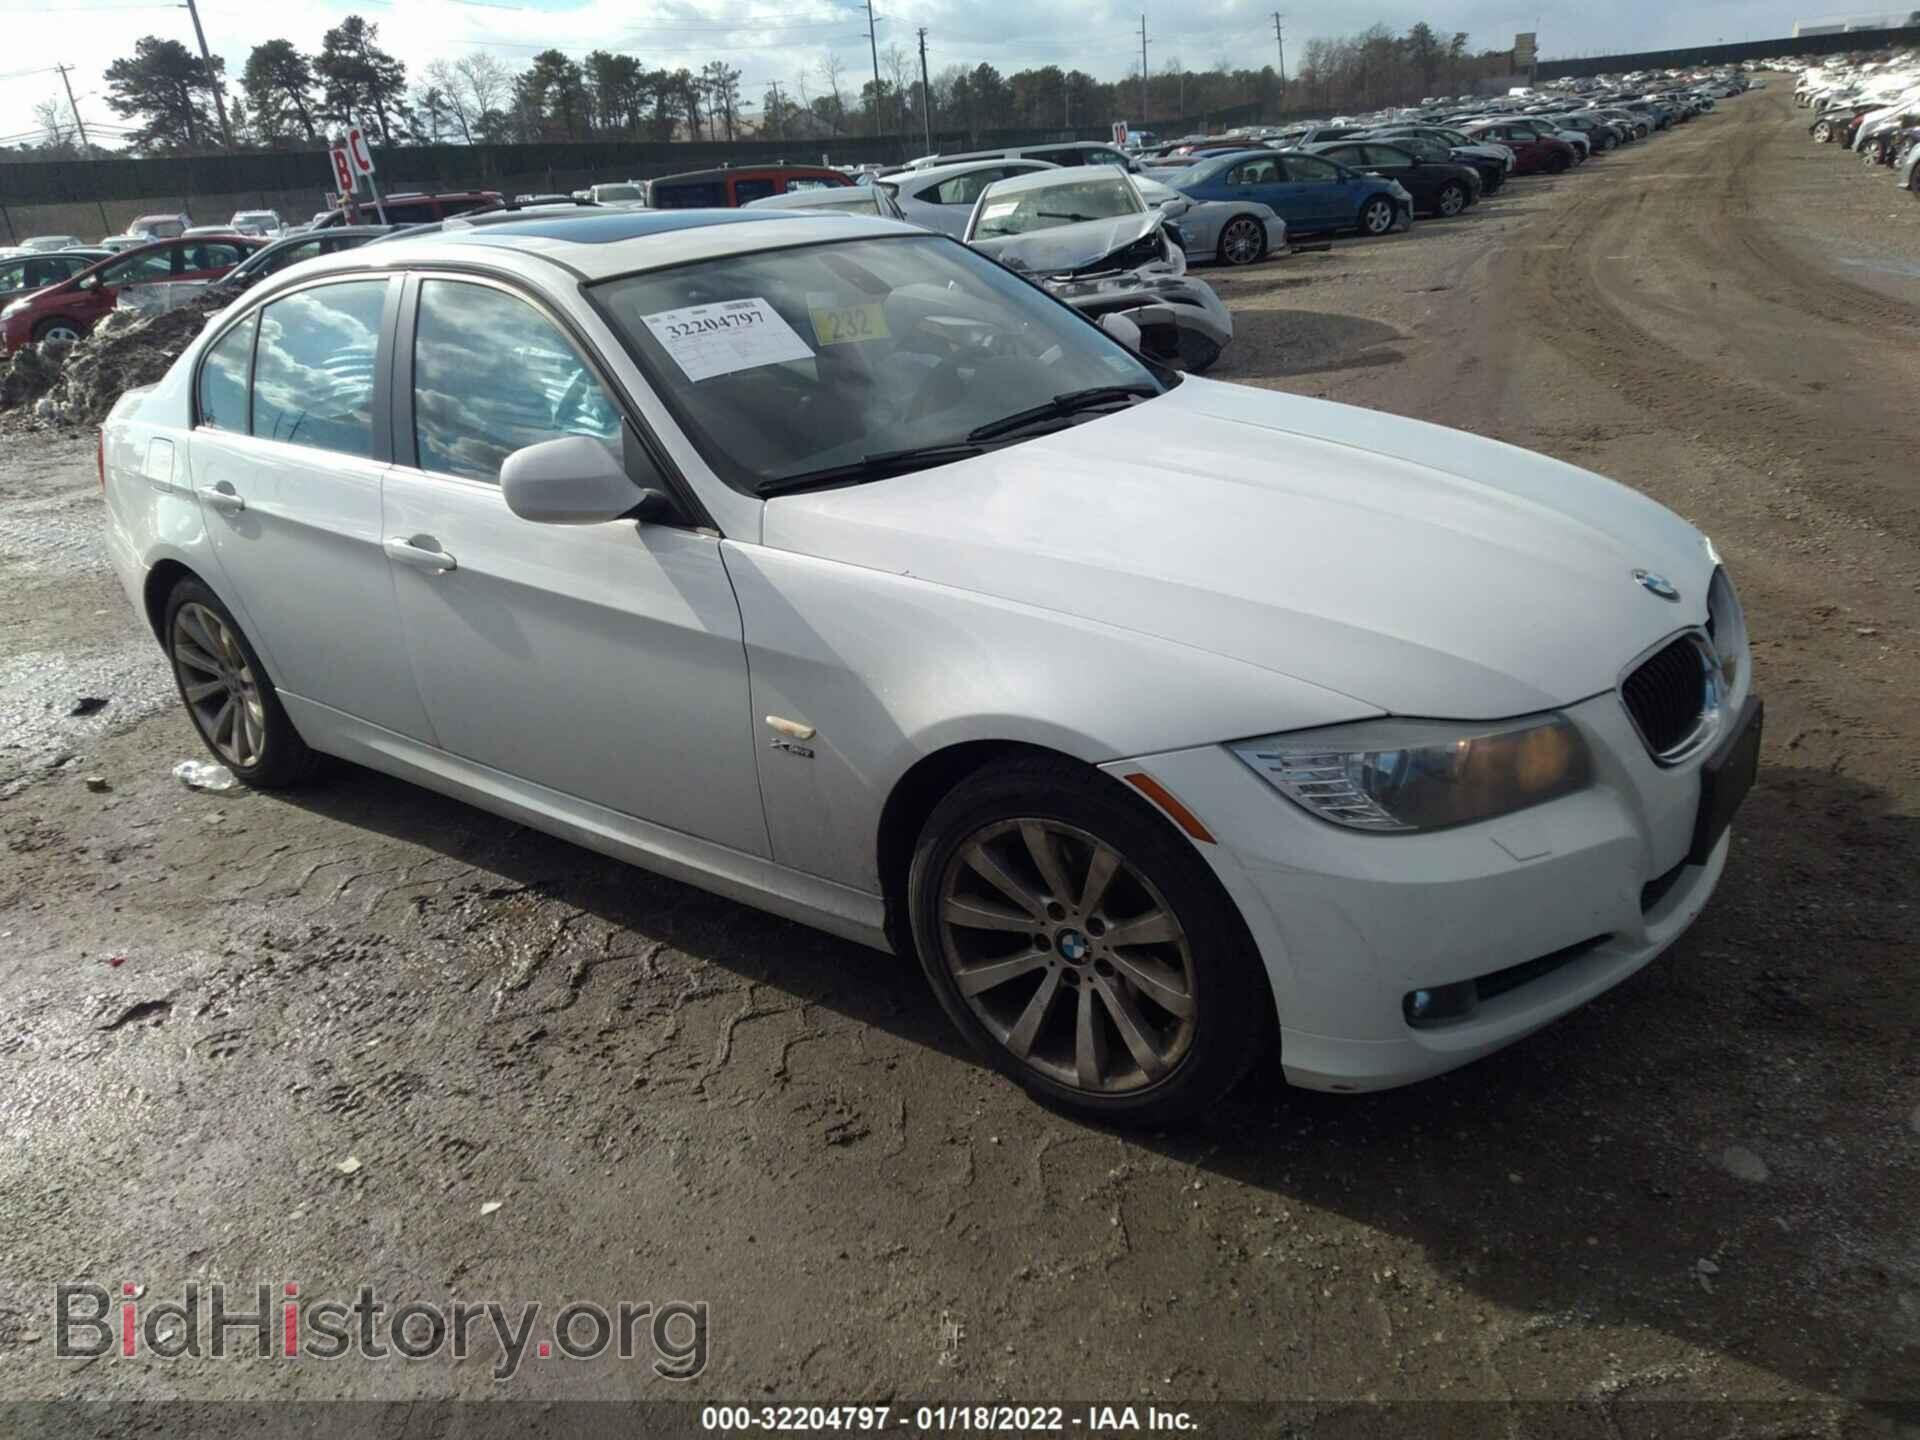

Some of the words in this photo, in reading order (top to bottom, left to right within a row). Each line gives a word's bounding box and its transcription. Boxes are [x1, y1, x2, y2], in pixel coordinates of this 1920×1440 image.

[1115, 124, 1126, 144] 10
[350, 130, 370, 171] C
[335, 150, 352, 190] B
[665, 310, 764, 339] 32204797
[832, 309, 873, 340] 232
